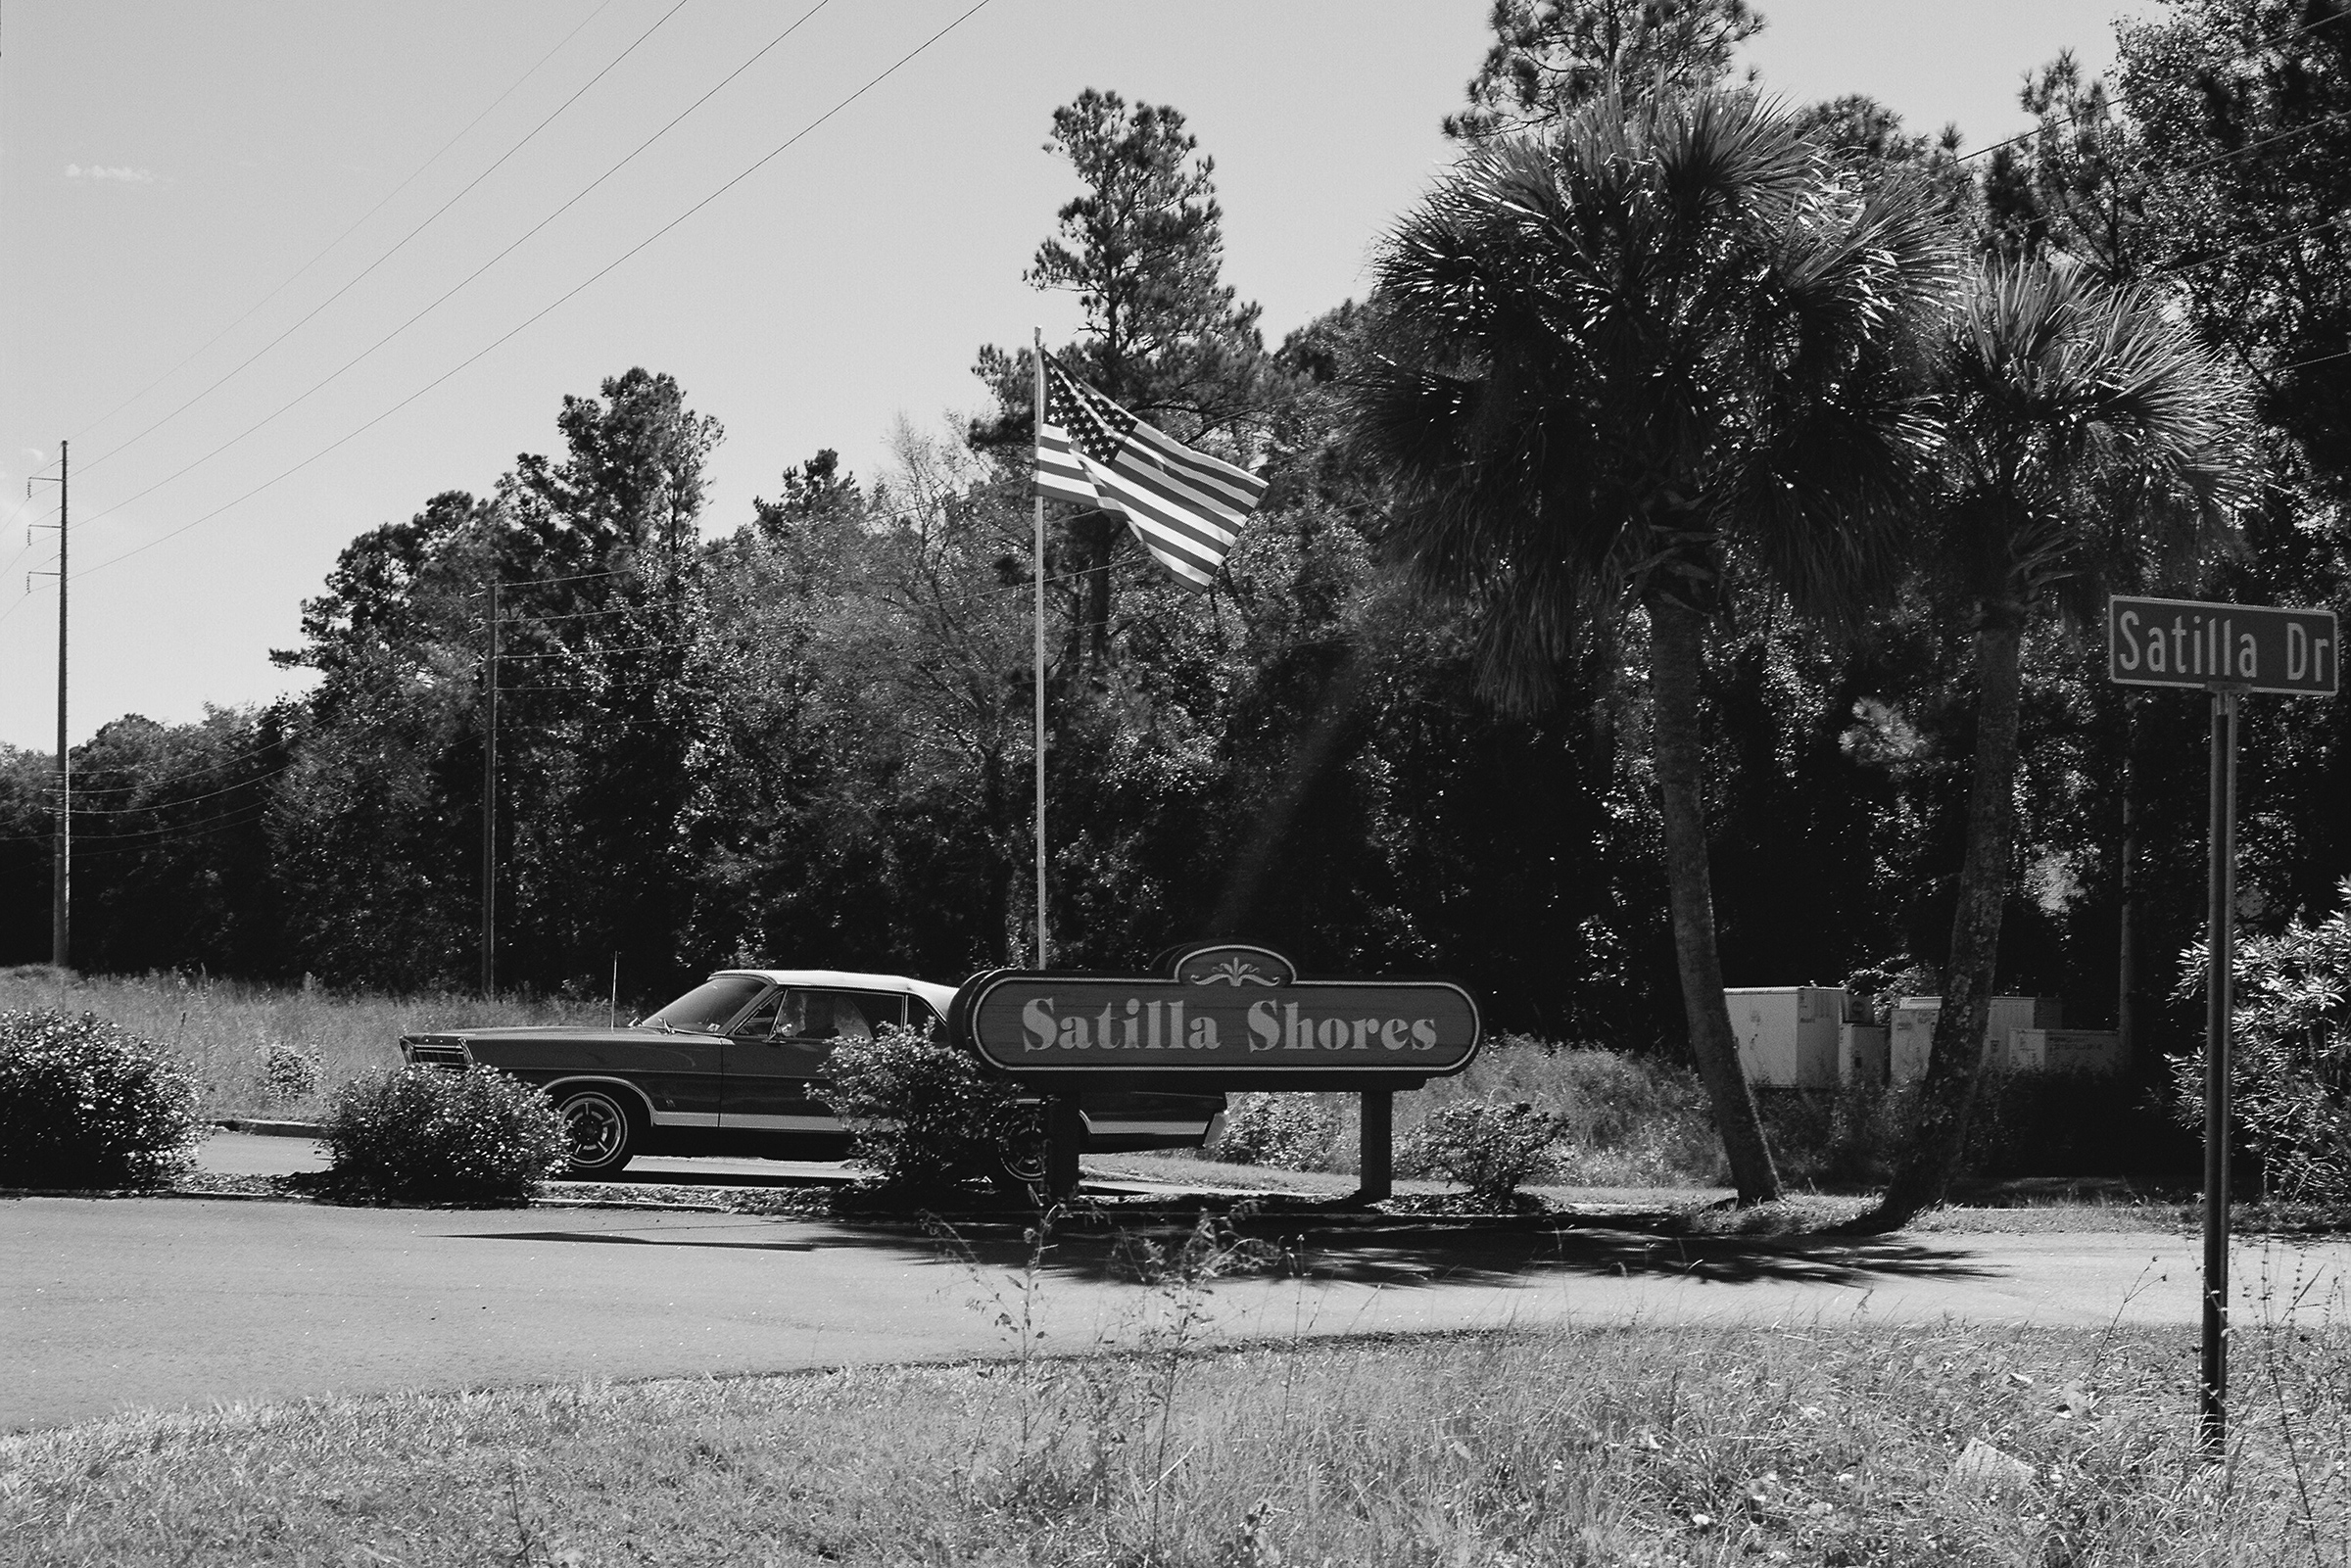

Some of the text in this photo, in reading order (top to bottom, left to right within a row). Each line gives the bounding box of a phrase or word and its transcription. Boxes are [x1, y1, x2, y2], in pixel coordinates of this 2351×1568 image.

[2119, 610, 2329, 683] Satilla Dr
[1022, 997, 1437, 1054] Satilla Shores
